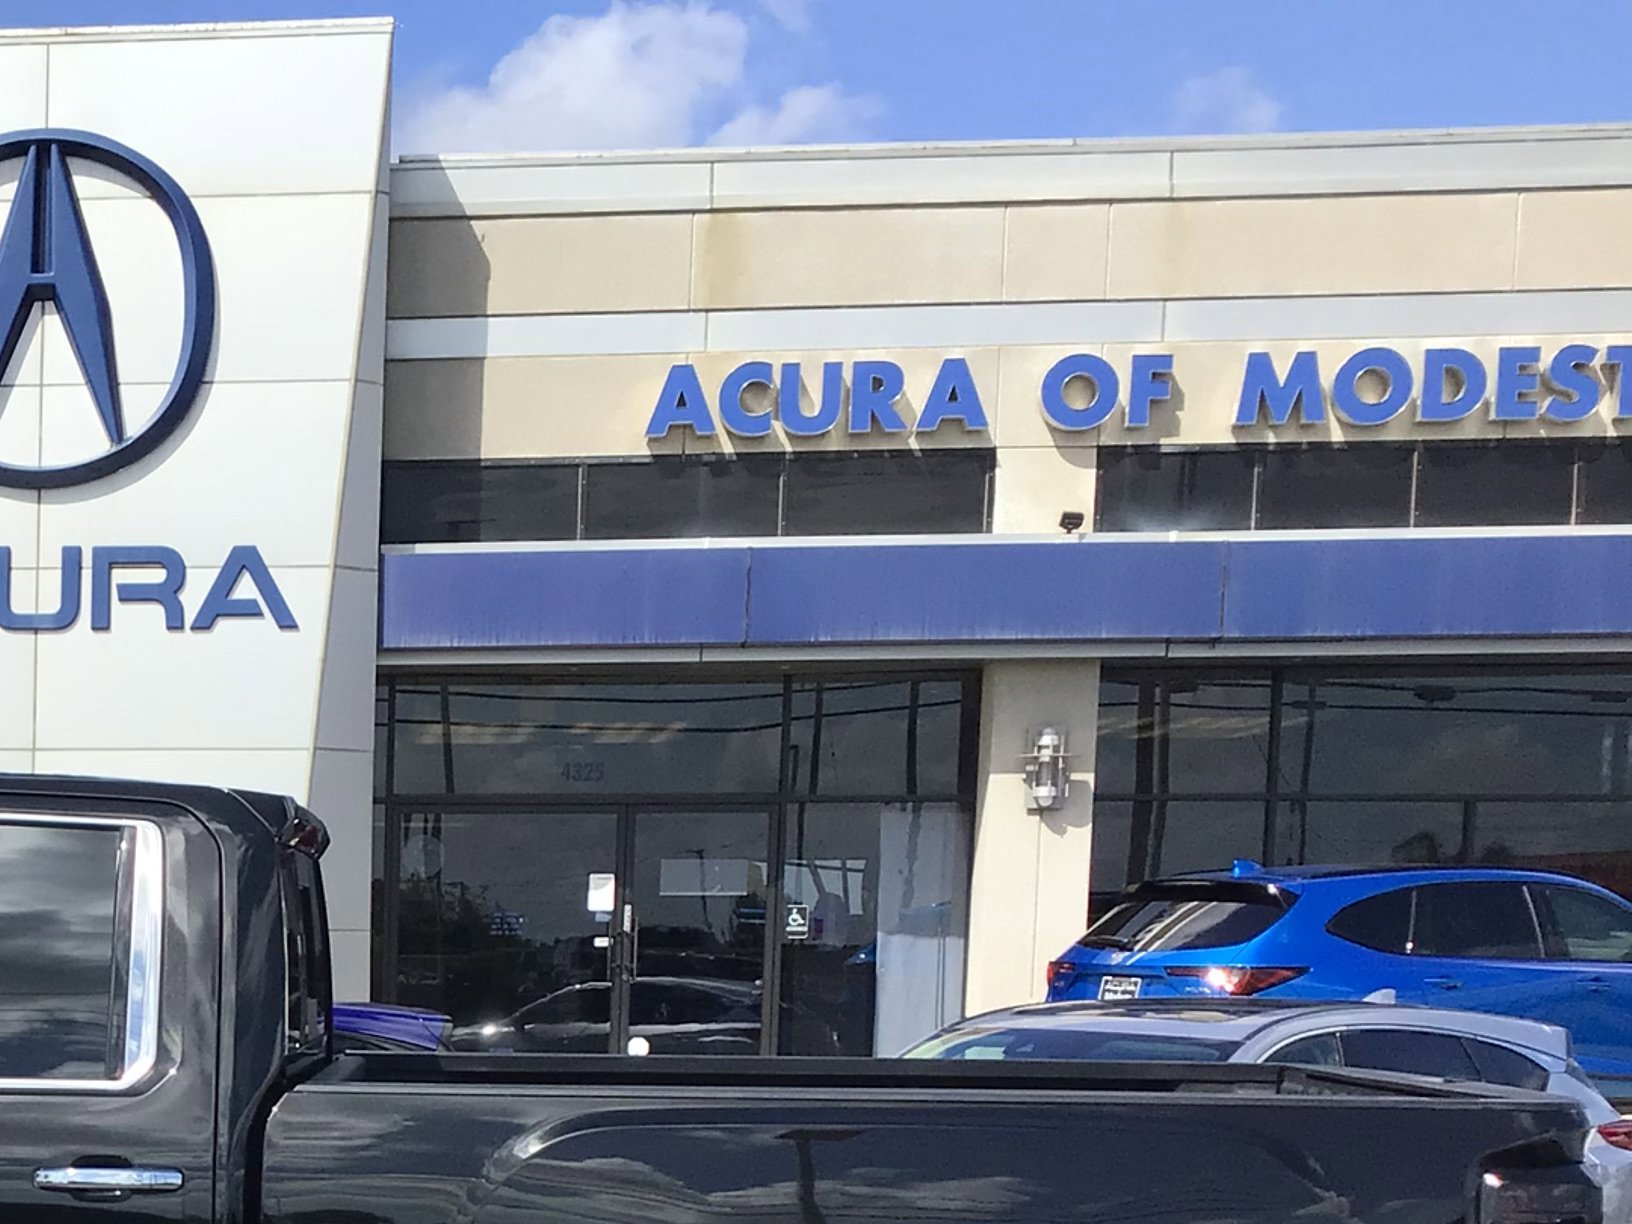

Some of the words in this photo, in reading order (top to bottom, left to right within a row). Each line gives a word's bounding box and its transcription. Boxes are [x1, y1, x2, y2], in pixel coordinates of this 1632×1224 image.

[645, 357, 989, 437] ACURA
[1041, 353, 1175, 430] OF
[1235, 344, 1632, 425] MODEST
[561, 762, 605, 781] 4325
